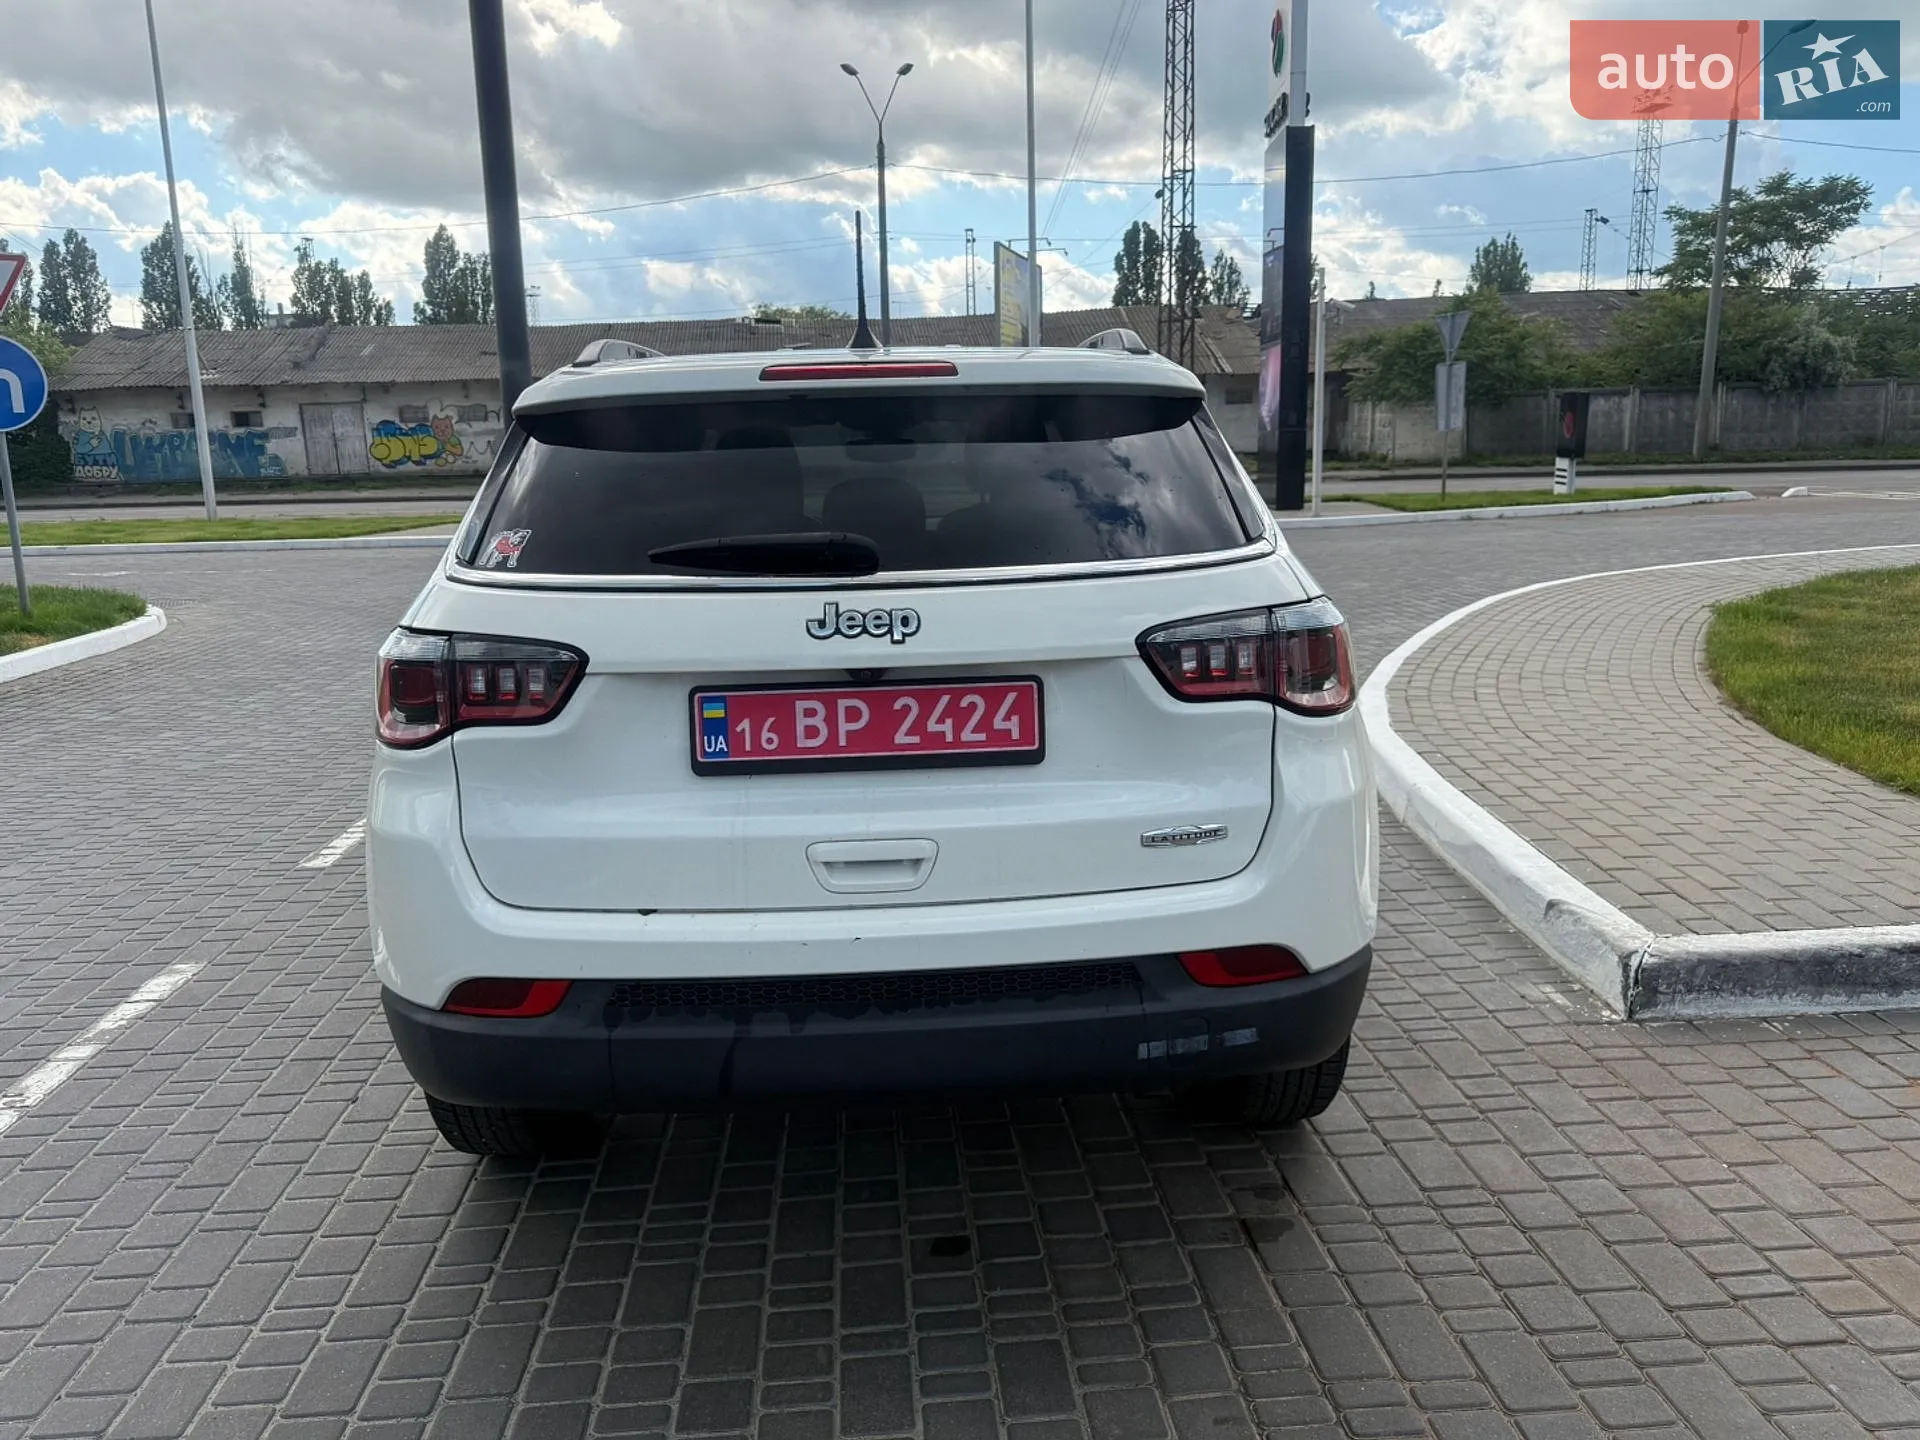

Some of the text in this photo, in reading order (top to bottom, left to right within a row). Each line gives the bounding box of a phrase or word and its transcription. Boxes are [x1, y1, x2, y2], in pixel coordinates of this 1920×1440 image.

[806, 601, 921, 644] Jeep
[735, 692, 1020, 752] 16 BP 2424
[703, 735, 728, 753] UA
